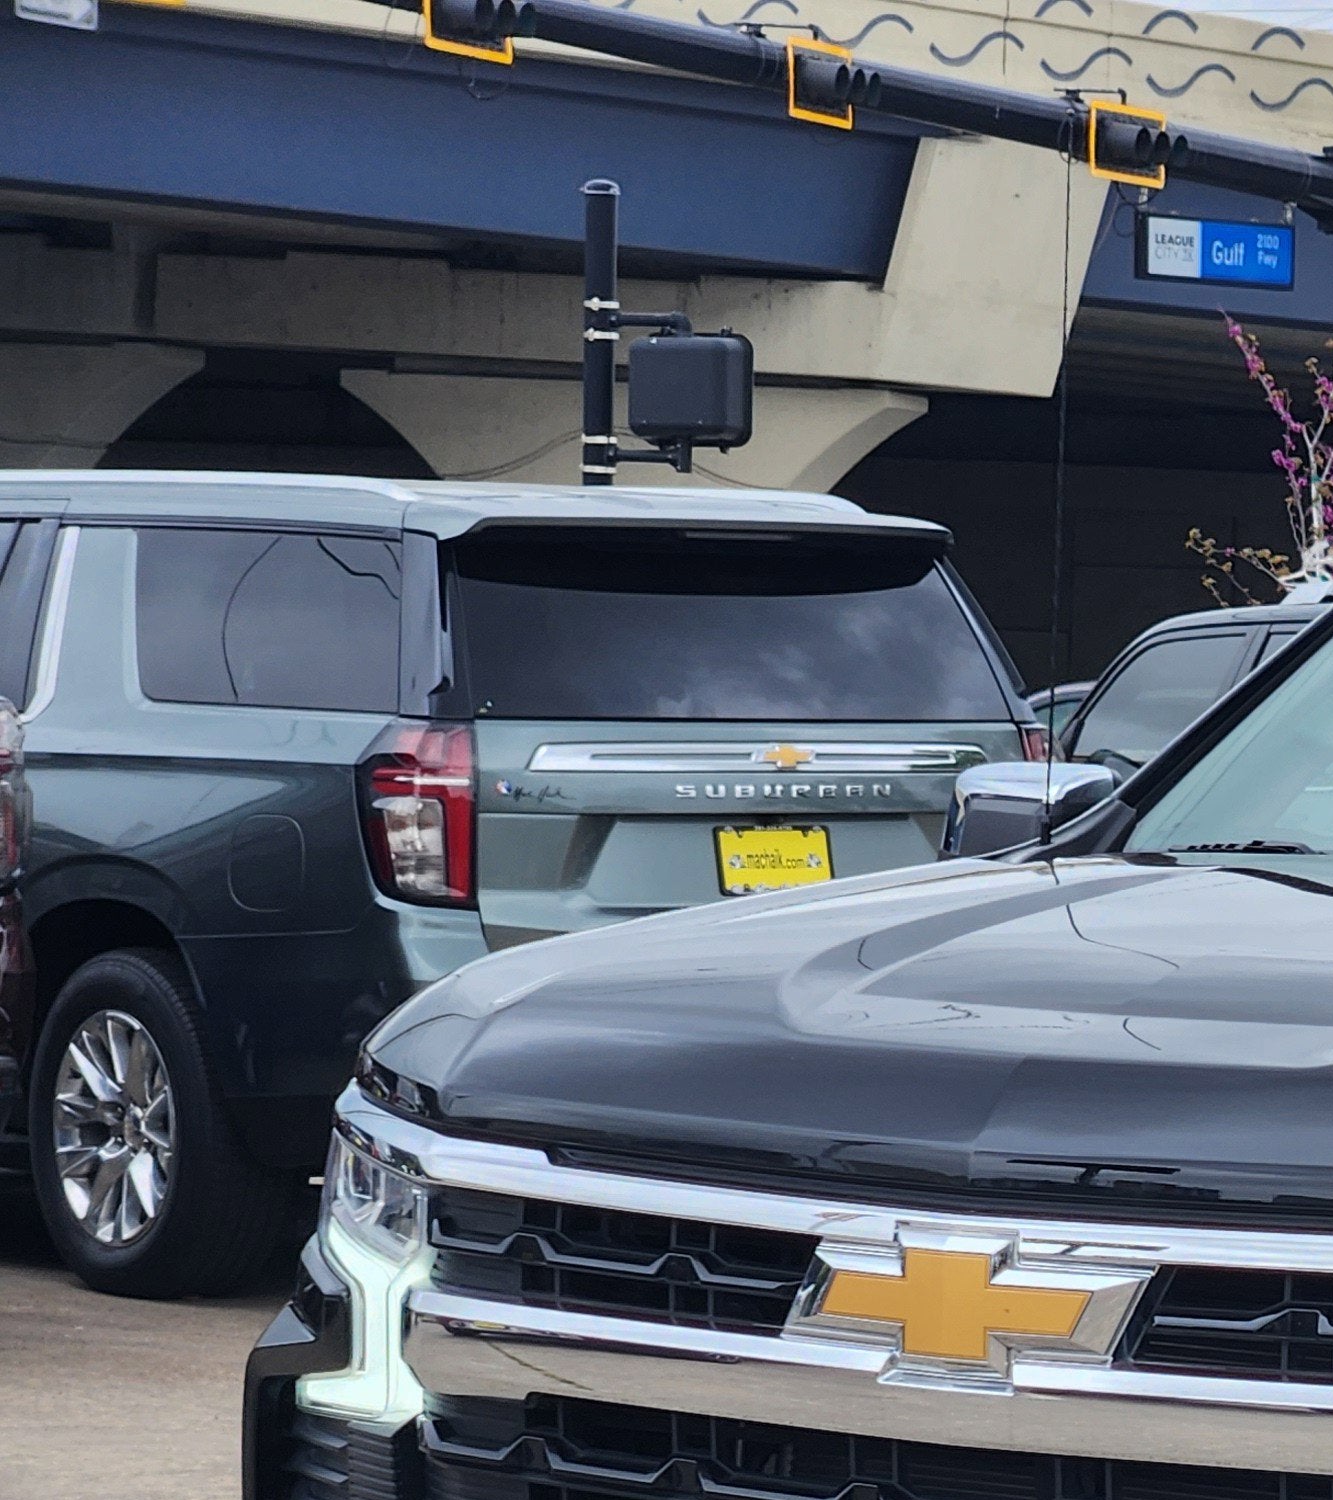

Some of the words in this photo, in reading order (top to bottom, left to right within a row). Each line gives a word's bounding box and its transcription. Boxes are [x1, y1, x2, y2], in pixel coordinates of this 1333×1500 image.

[1154, 233, 1195, 247] LEAGUE
[1256, 233, 1280, 250] 2100
[1154, 247, 1179, 260] CITY
[1211, 240, 1245, 267] Gulf
[1257, 251, 1278, 269] Fwy
[675, 783, 891, 799] SUBURBAN
